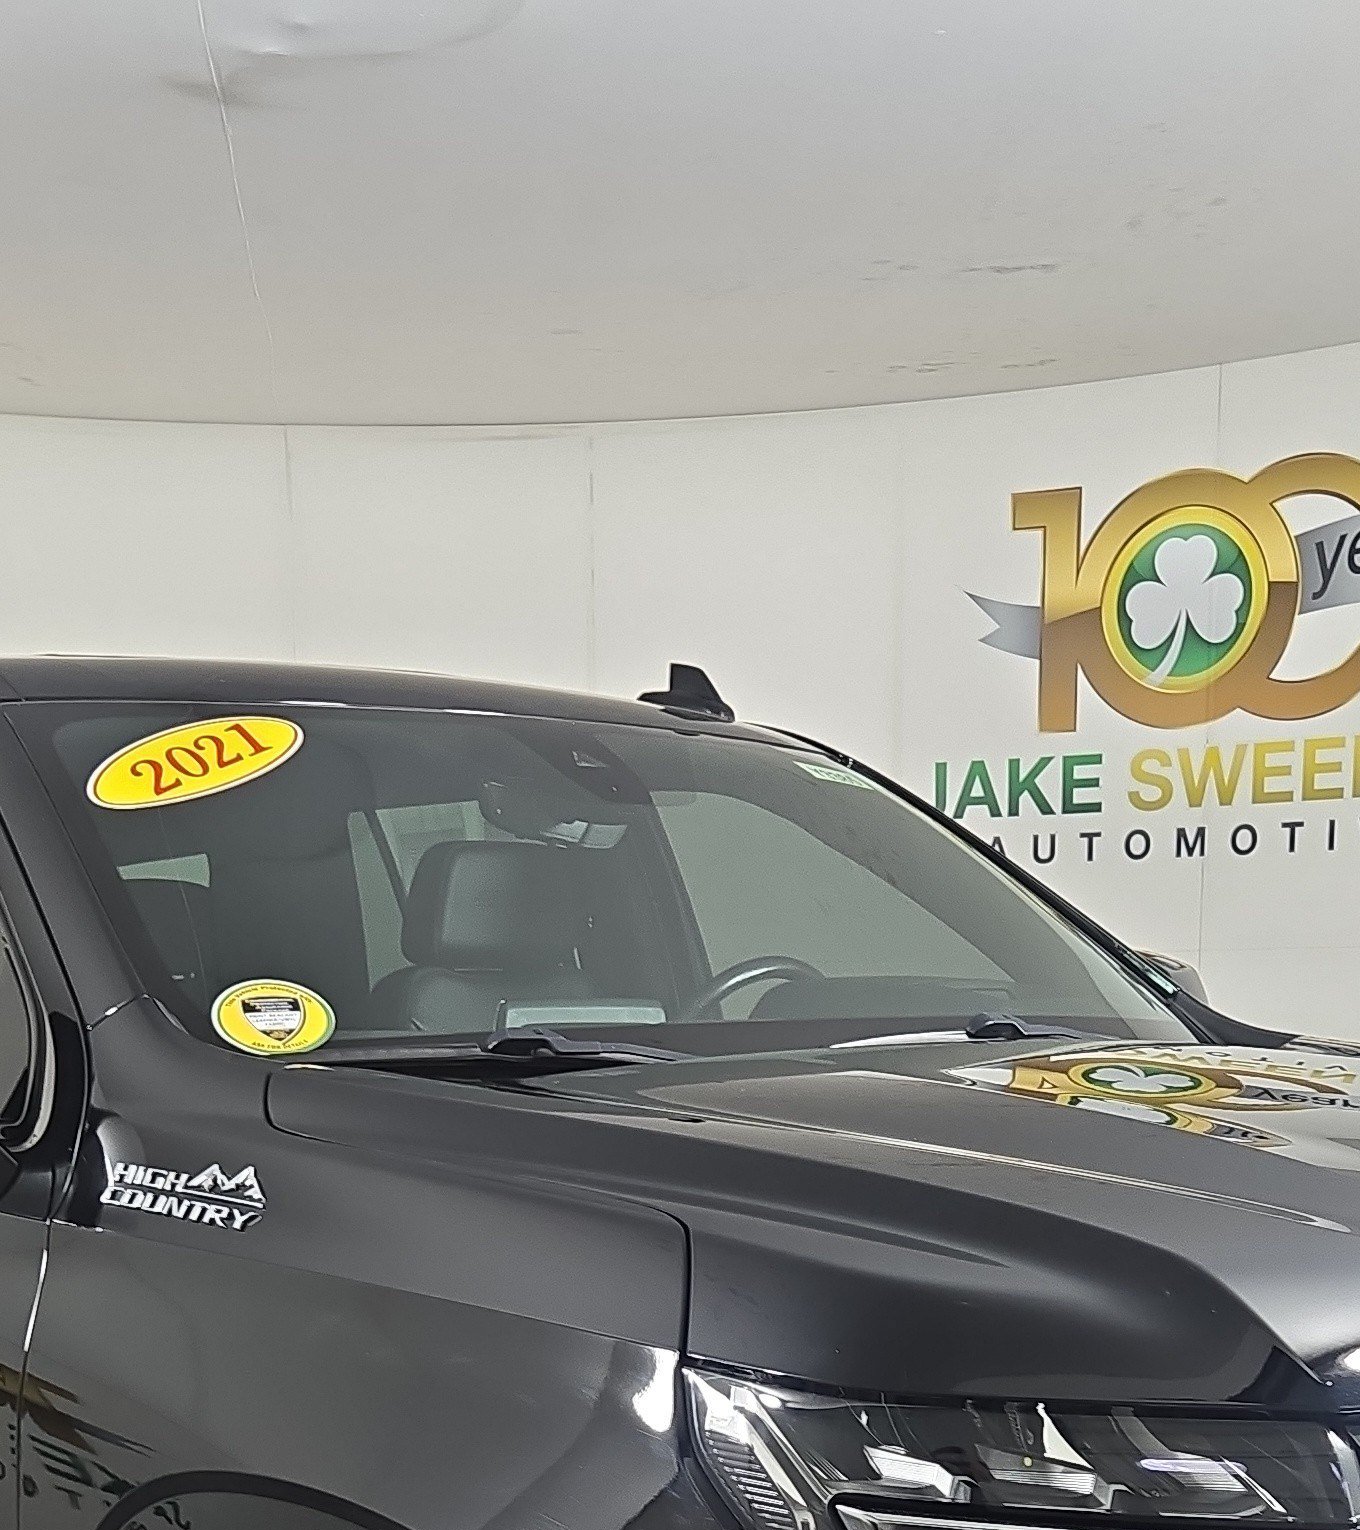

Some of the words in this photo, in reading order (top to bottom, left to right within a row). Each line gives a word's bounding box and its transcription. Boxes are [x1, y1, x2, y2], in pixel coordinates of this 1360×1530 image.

[130, 723, 273, 796] 2021
[934, 753, 1103, 820] JAKE
[114, 1162, 190, 1193] HIGH
[100, 1186, 263, 1231] COUNTRY
